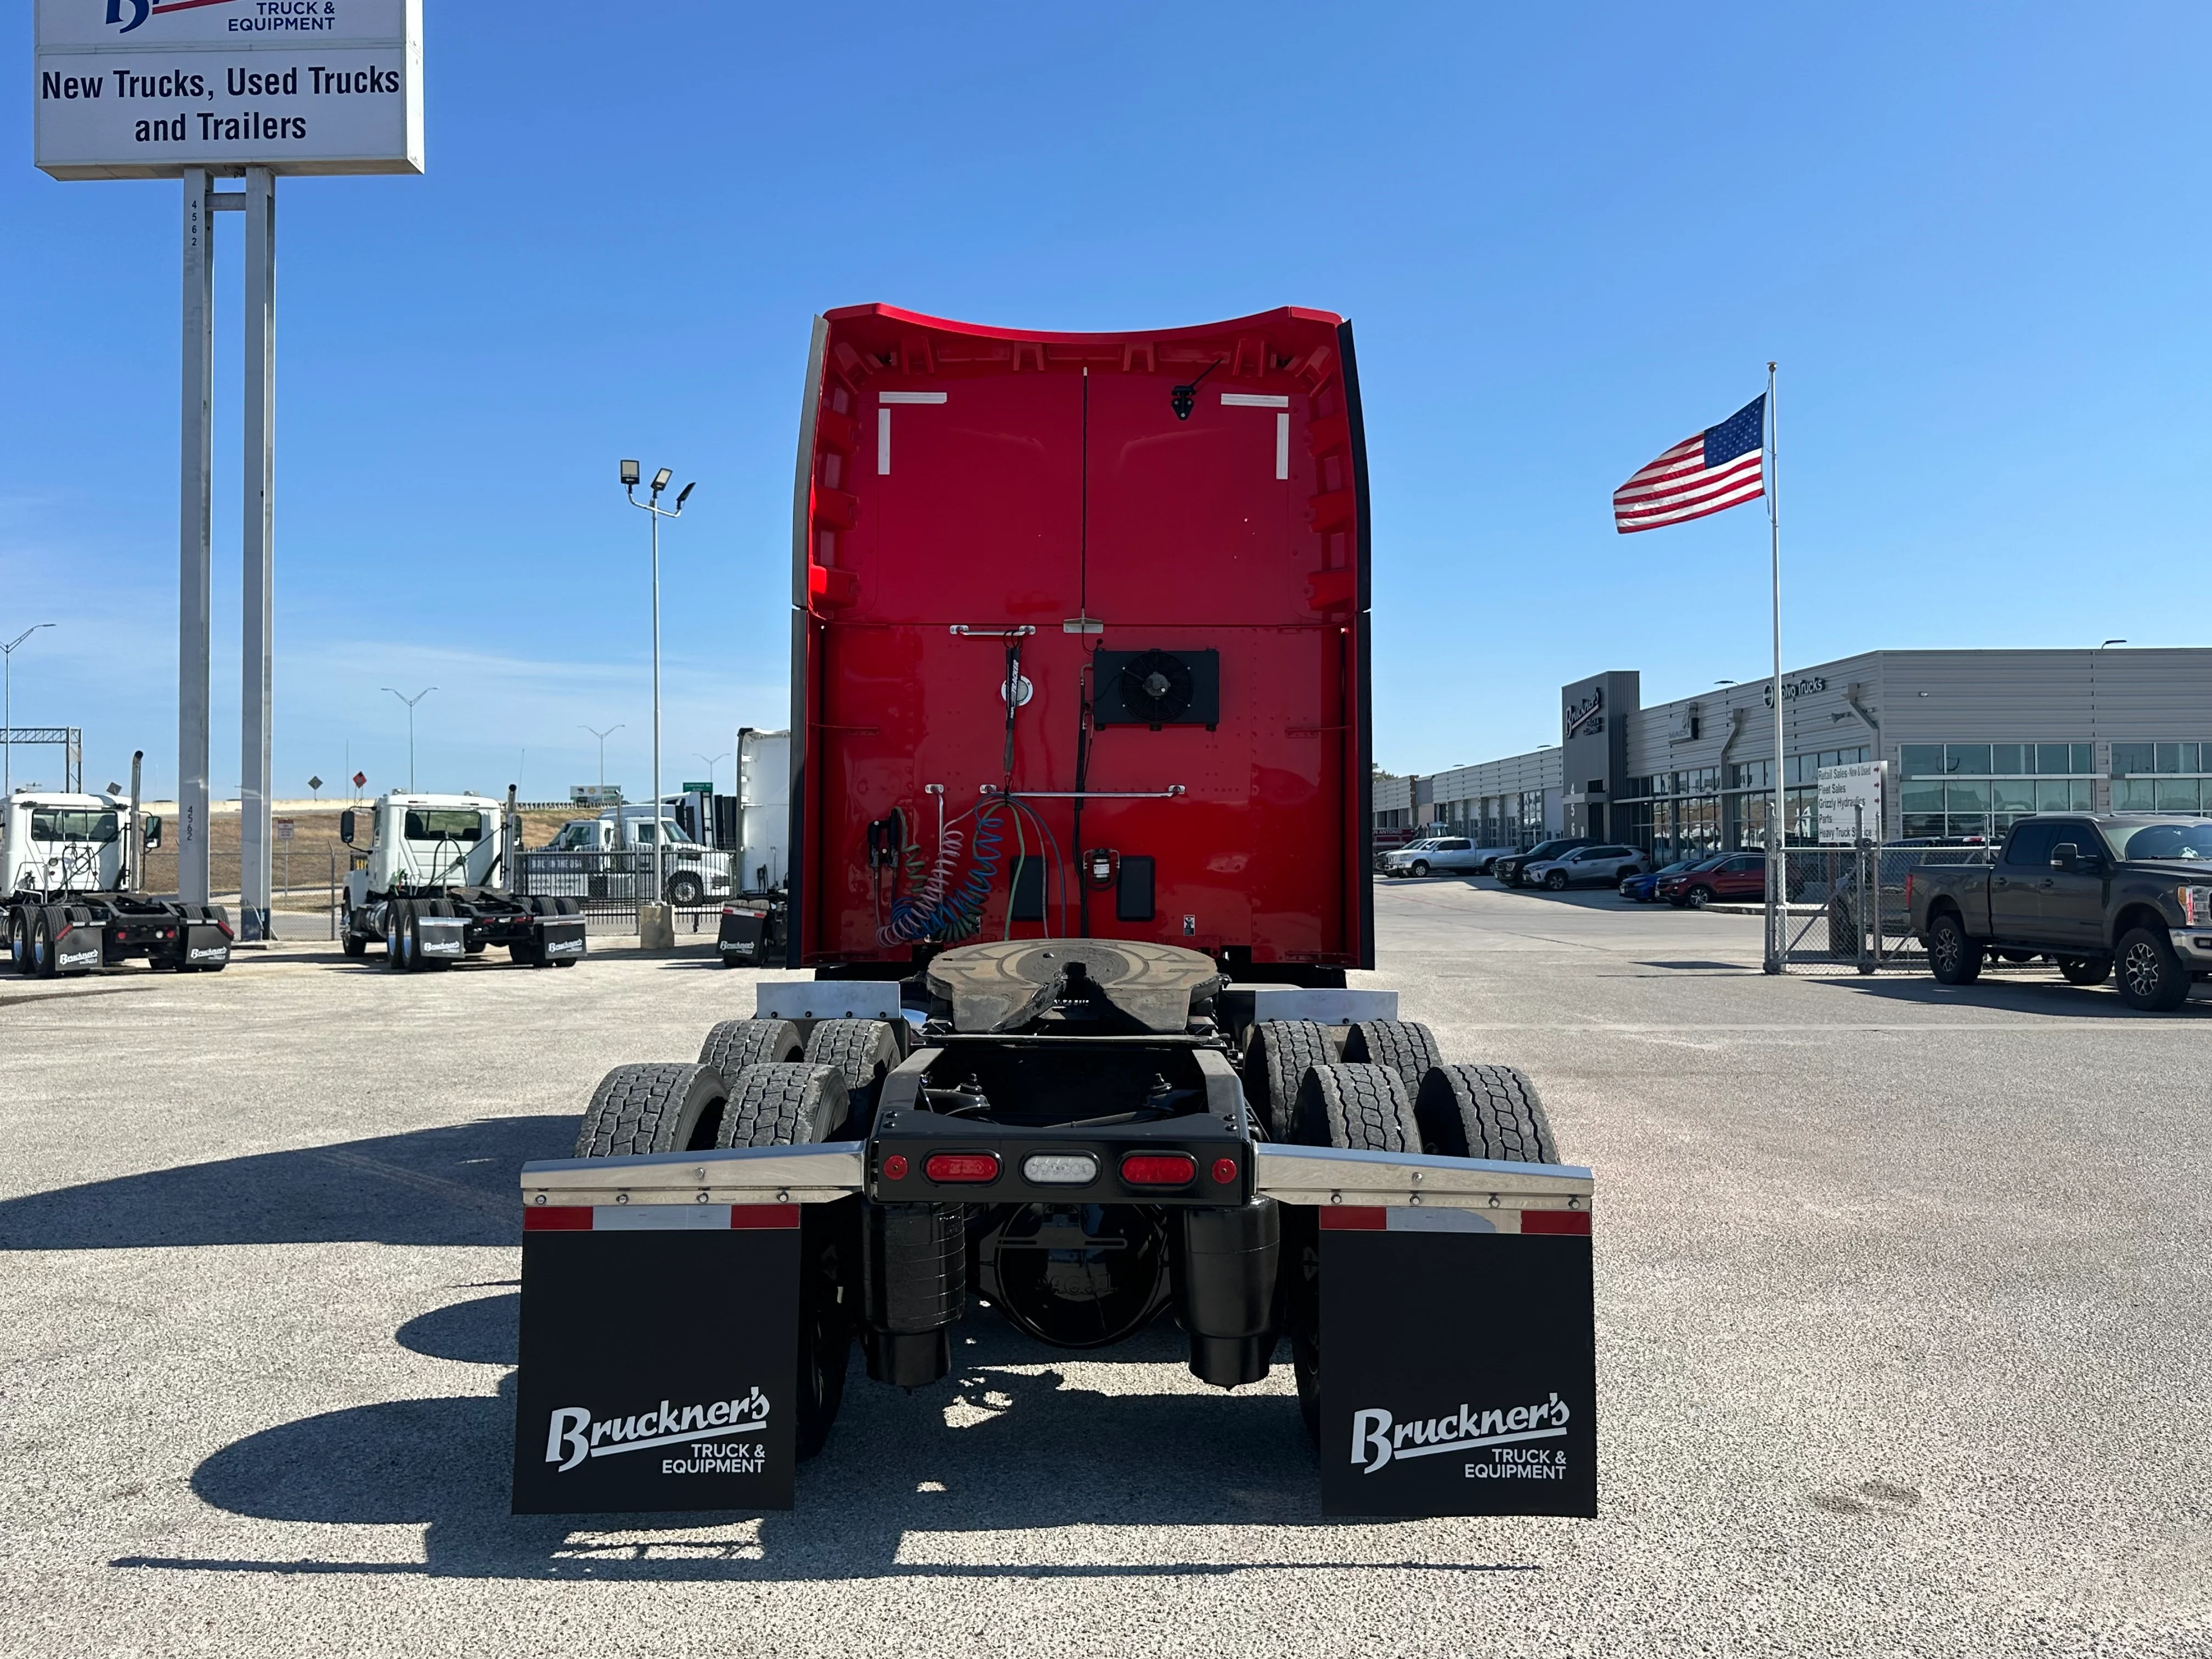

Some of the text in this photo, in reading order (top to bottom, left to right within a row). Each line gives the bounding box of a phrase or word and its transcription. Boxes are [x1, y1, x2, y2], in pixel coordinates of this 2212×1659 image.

[256, 2, 335, 15] TRUCK &
[228, 17, 335, 32] EQUIPMENT
[42, 65, 400, 101] New Trucks, Used Trucks
[135, 112, 307, 142] and Trailers
[1798, 677, 1823, 695] Trucks
[1818, 769, 1832, 780] Retail
[1861, 765, 1871, 776] Used
[1818, 783, 1846, 795] Fleet Sales
[1819, 798, 1836, 810] Grizzly
[1819, 814, 1832, 824] Parts
[1819, 827, 1835, 840] Heavy
[1836, 827, 1850, 837] Truck
[545, 1386, 770, 1472] Bruckner's
[1351, 1392, 1570, 1475] Bruckner's
[691, 1443, 766, 1458] TRUCK &
[1491, 1448, 1567, 1464] TRUCK &
[662, 1459, 765, 1474] EQUIPMENT
[1464, 1463, 1567, 1480] EQUIPMENT
